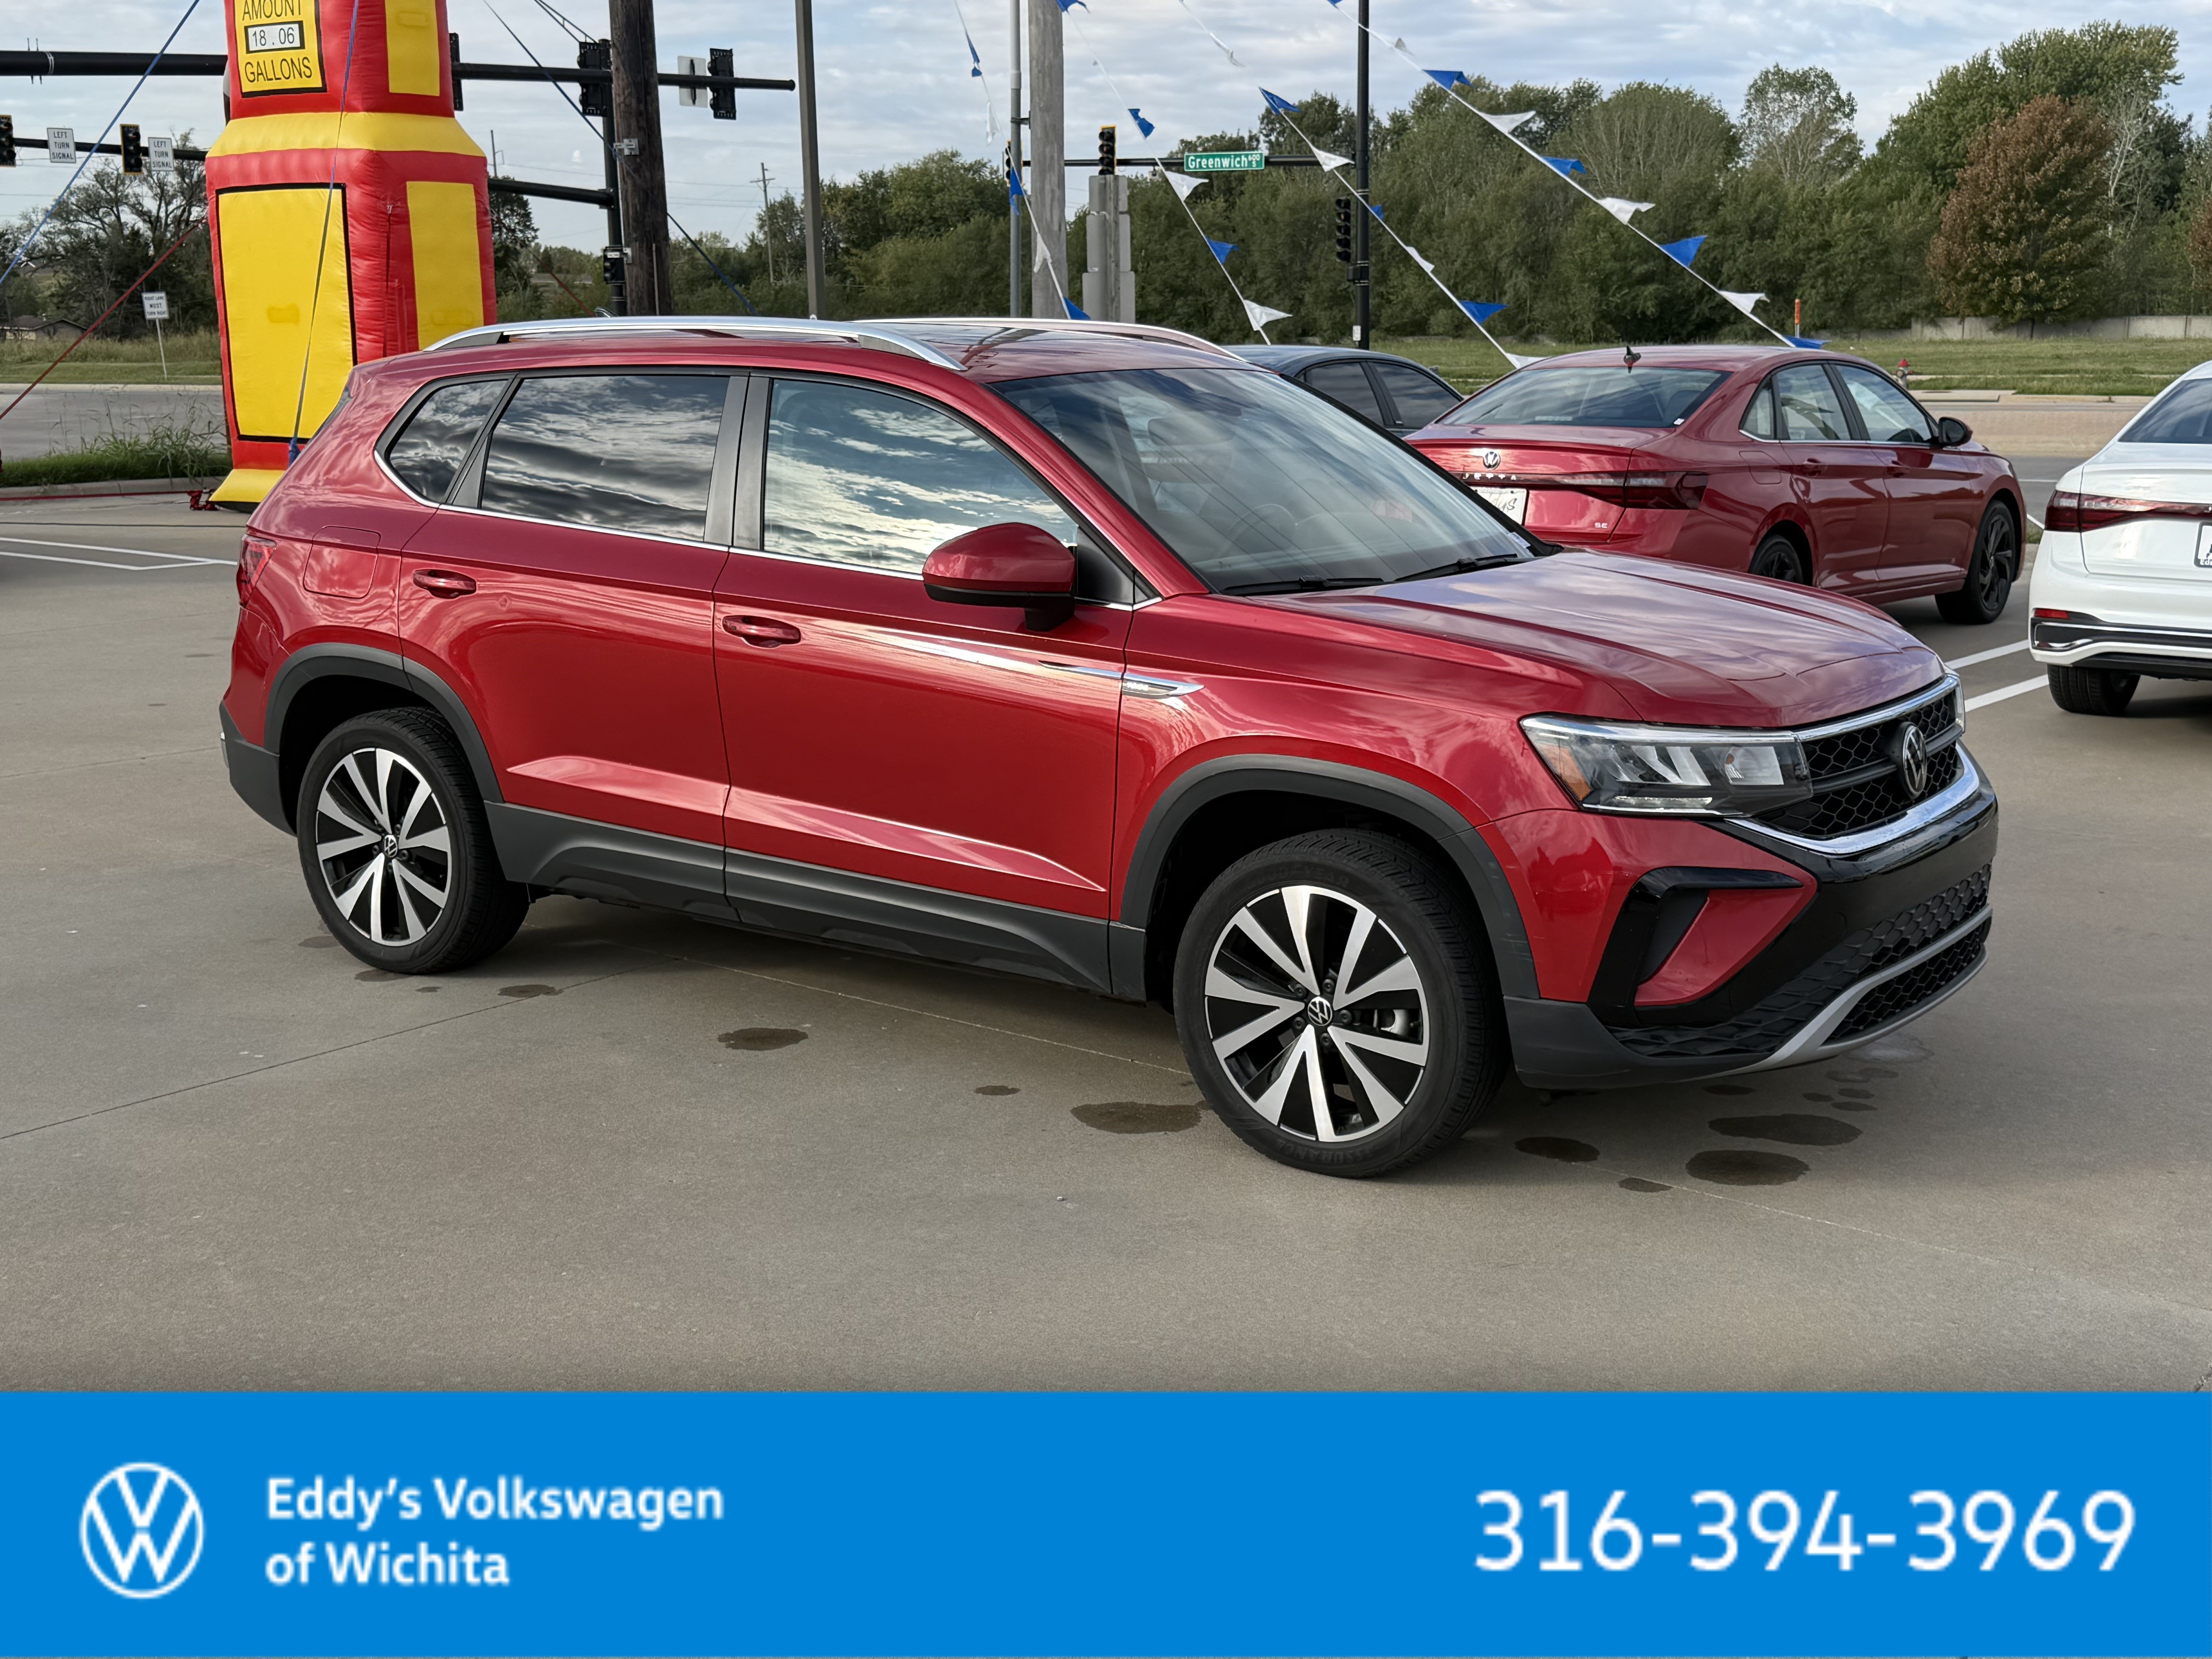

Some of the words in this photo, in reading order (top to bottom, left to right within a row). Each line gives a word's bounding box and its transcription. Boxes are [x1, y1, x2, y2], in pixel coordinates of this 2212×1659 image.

[242, 0, 301, 21] AMOUNT
[244, 57, 312, 83] GALLONS
[1188, 155, 1248, 168] Greenwich
